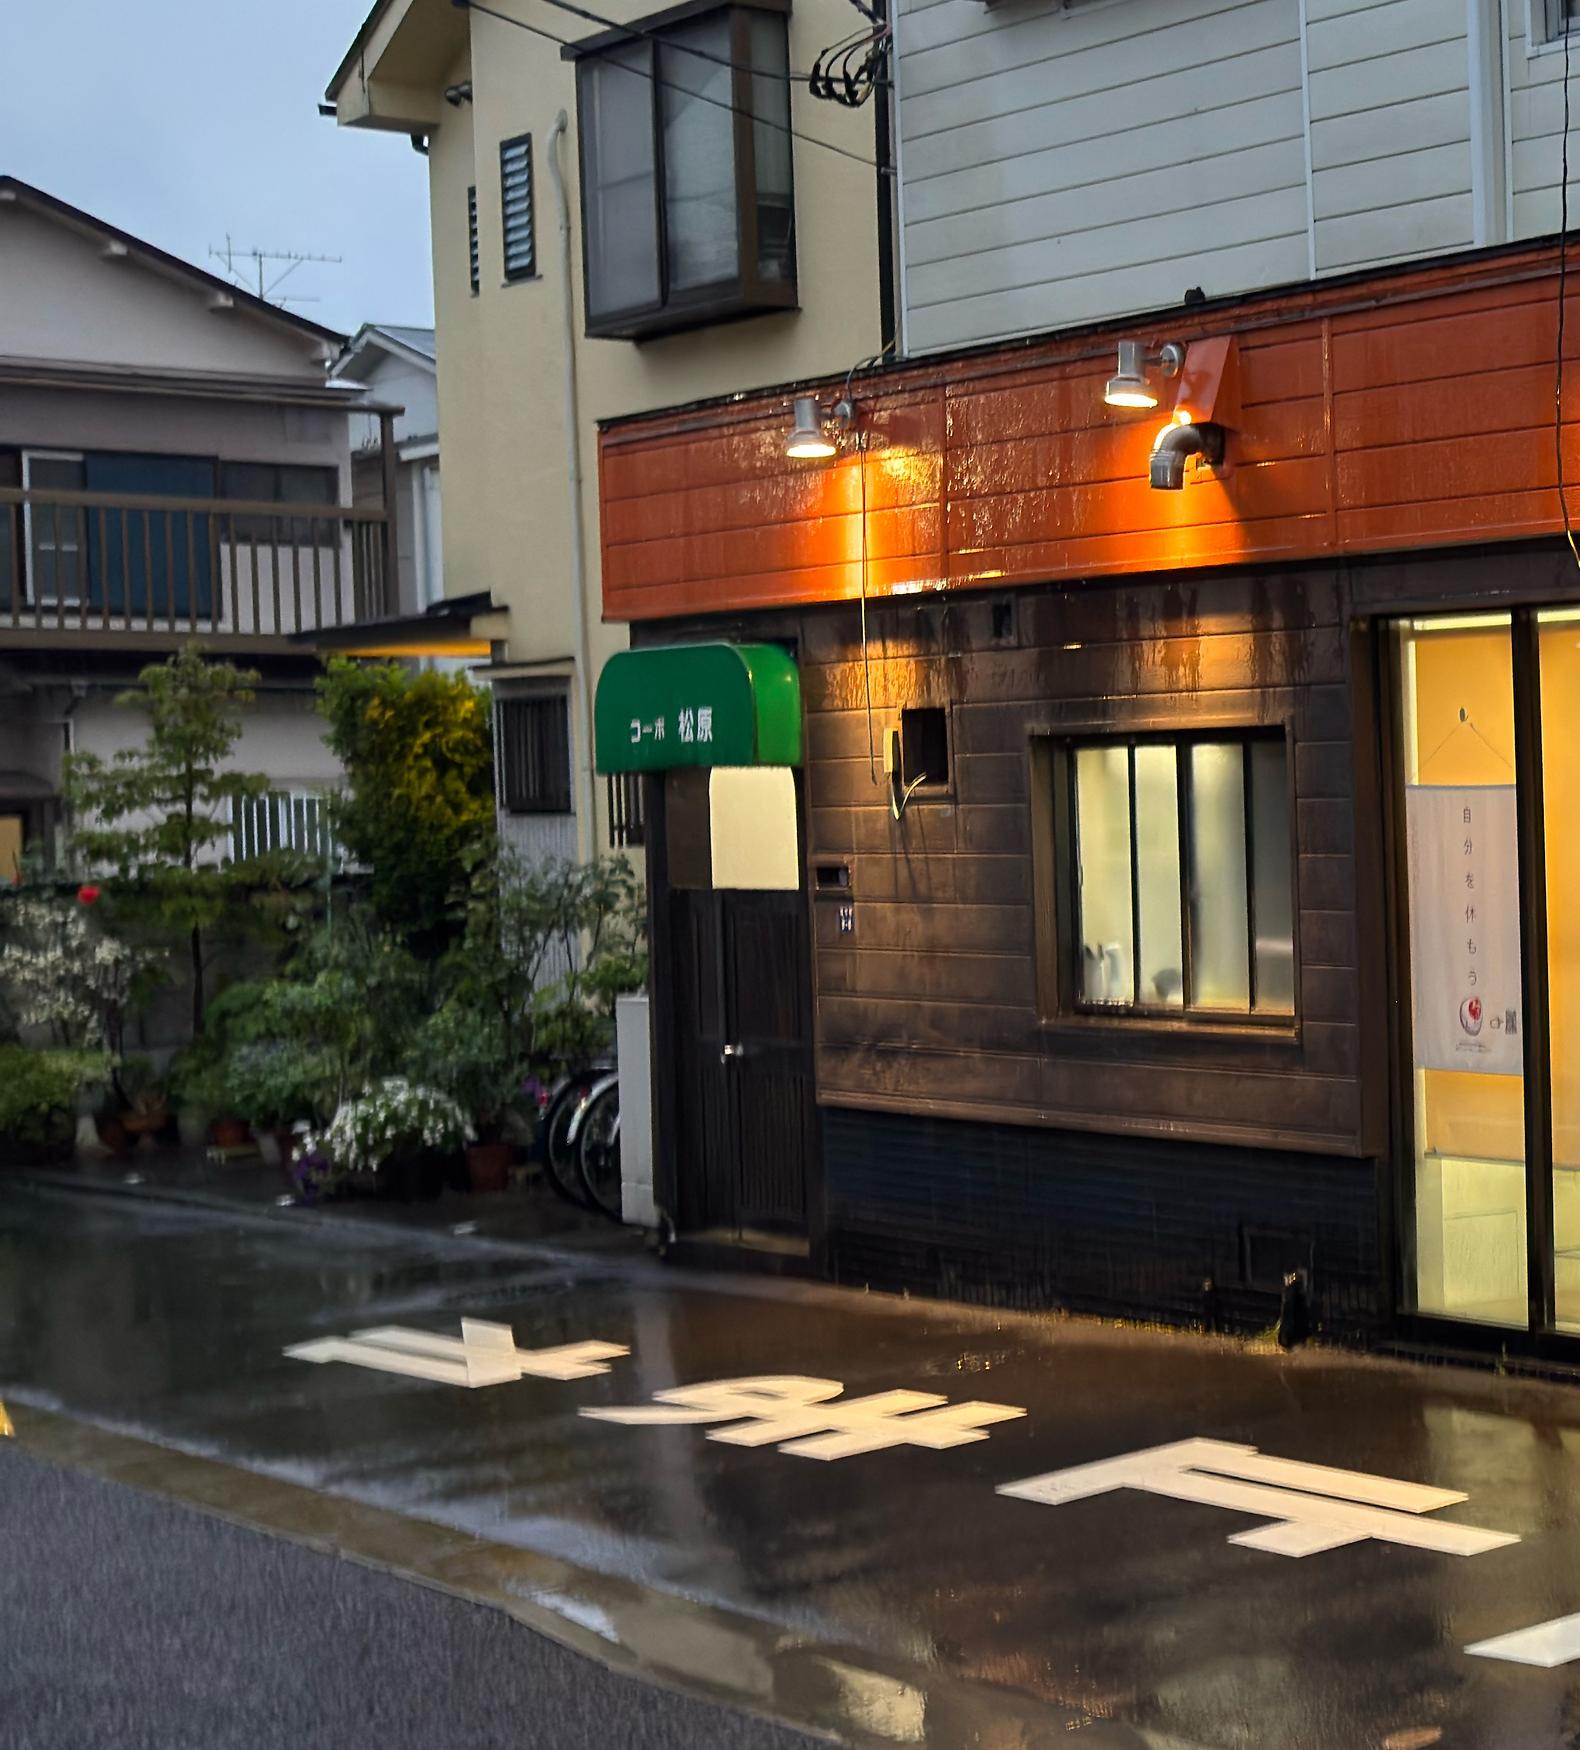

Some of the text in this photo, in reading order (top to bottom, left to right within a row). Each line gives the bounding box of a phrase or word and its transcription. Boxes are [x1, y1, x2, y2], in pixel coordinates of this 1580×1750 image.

[678, 706, 713, 743] 松原
[1462, 807, 1478, 986] 自分を休もう
